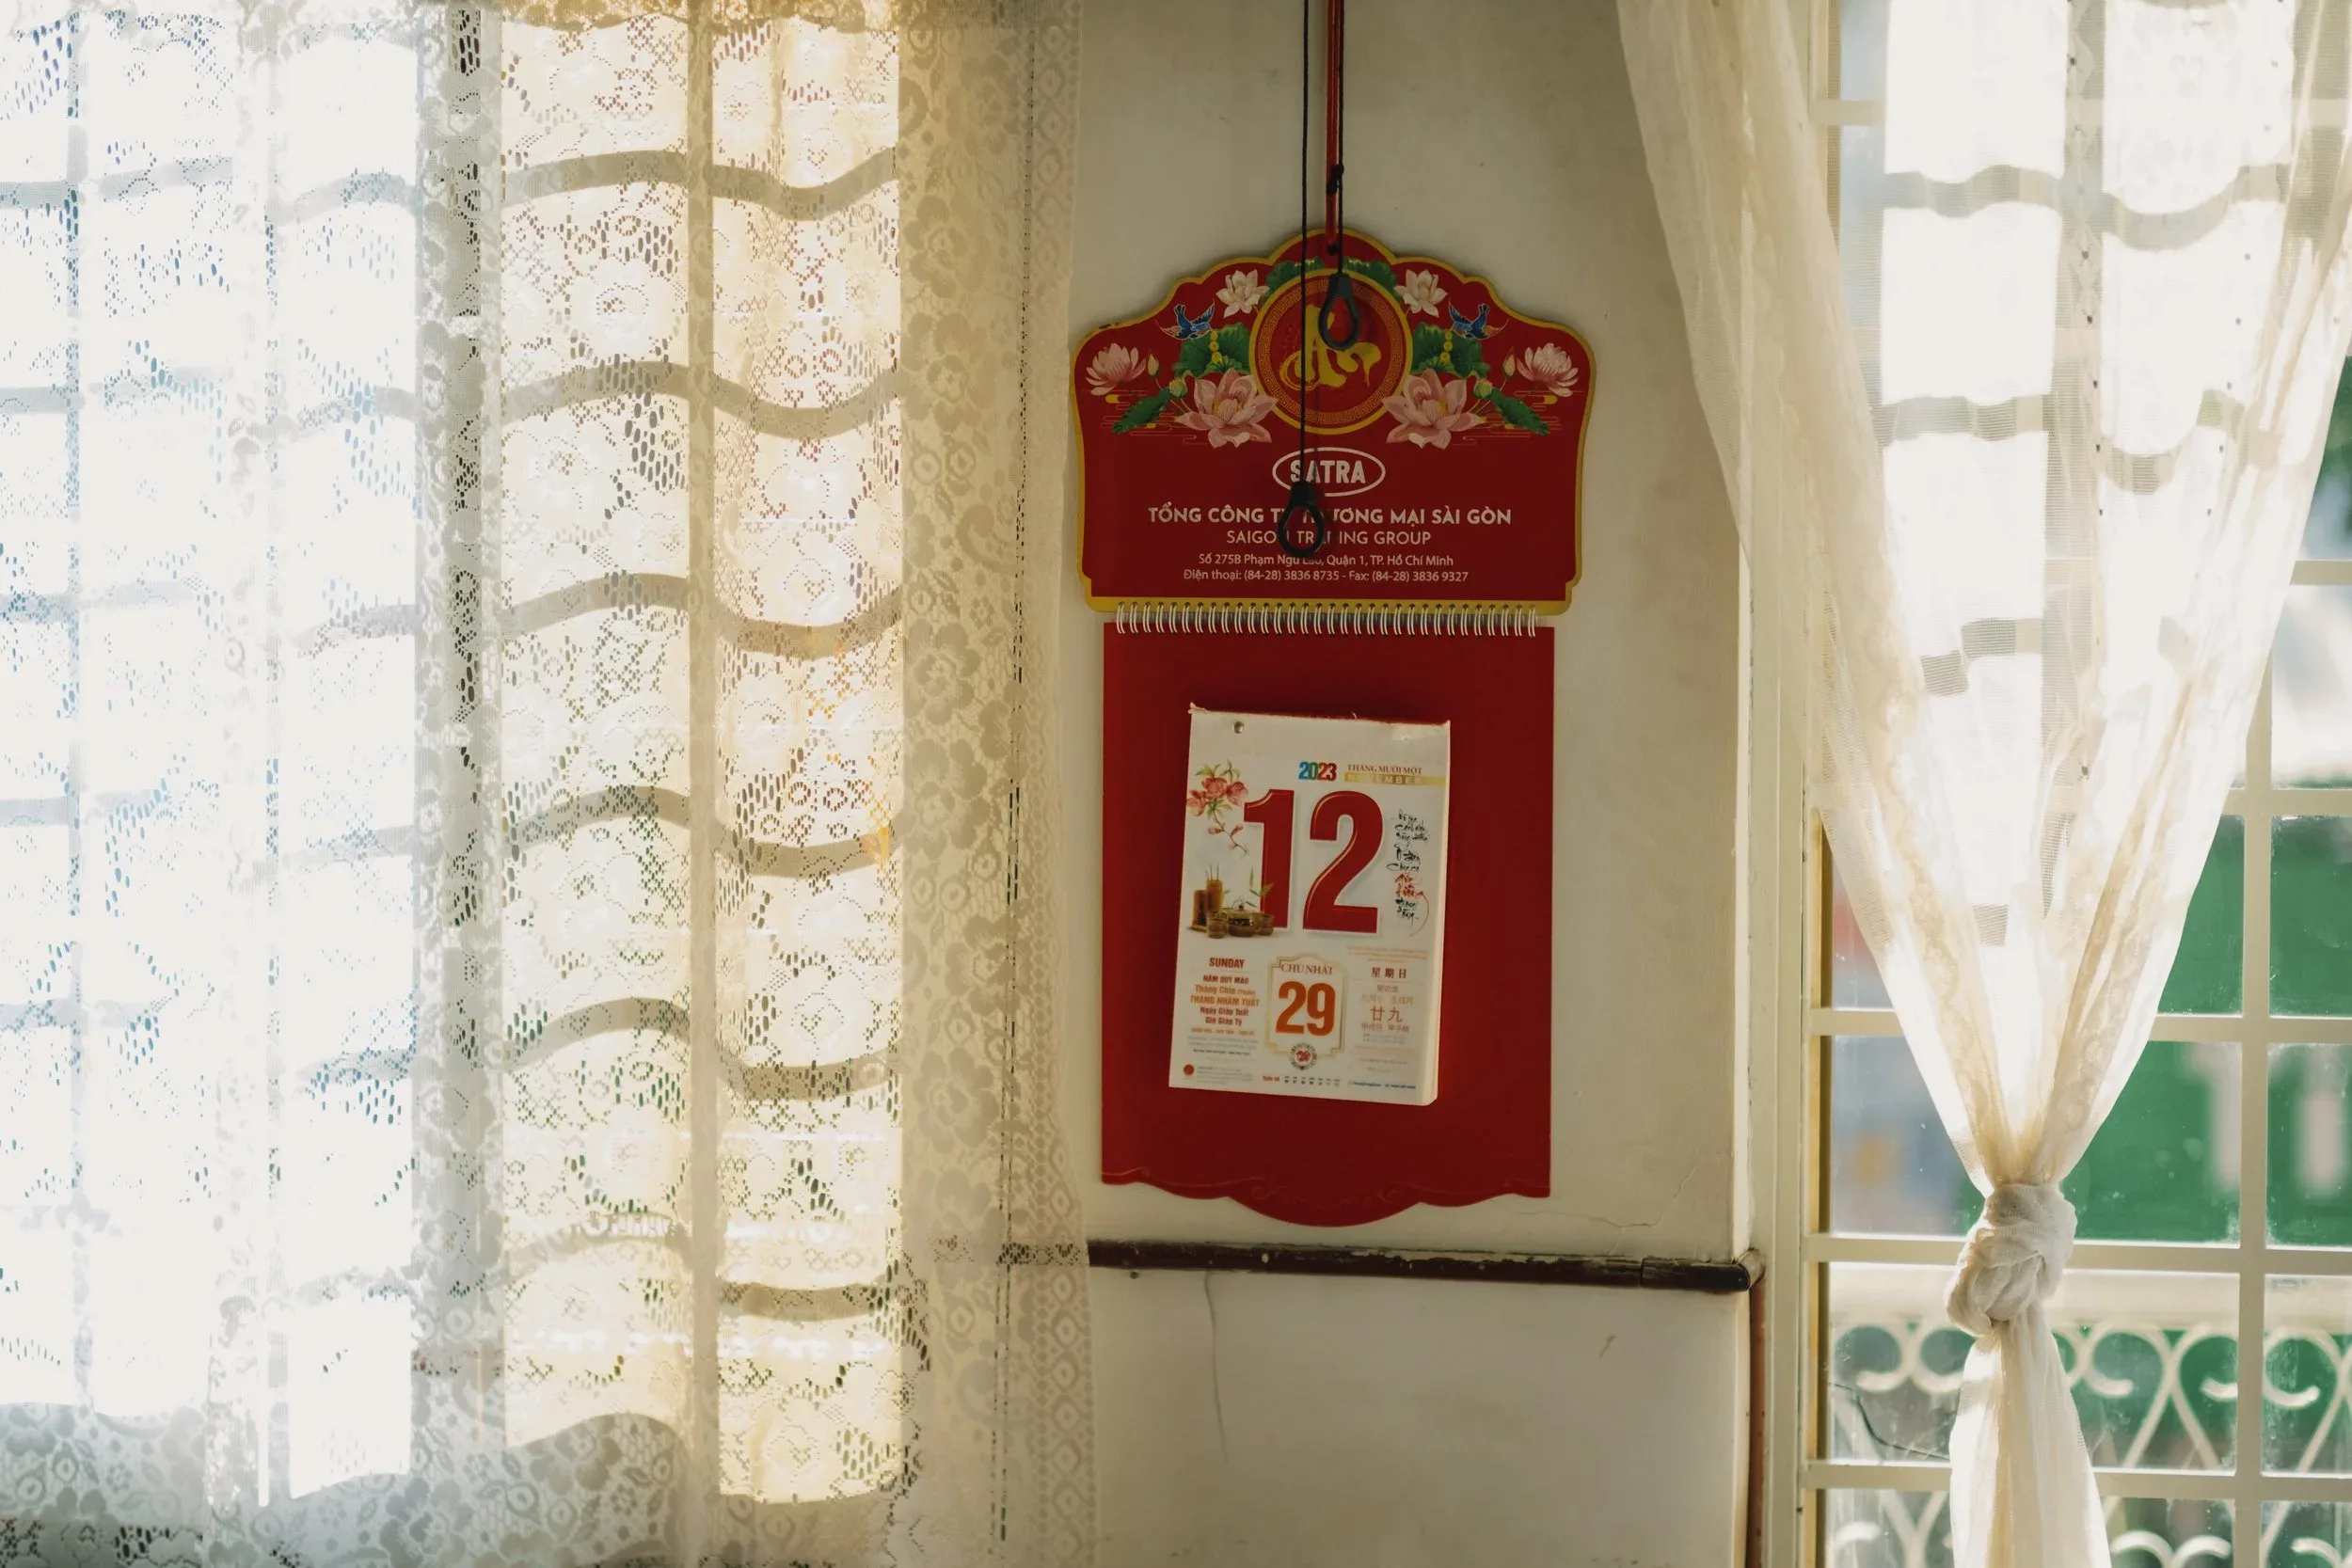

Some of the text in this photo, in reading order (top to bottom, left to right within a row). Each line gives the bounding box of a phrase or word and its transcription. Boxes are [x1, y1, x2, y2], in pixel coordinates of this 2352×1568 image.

[1290, 460, 1366, 483] SATRA
[1148, 501, 1201, 523] TỔNG
[1208, 504, 1263, 523] CÔNG
[1391, 509, 1425, 527] MẠI
[1431, 505, 1460, 525] SÀI
[1467, 506, 1511, 525] GÒN
[1296, 531, 1368, 545] TRING
[1374, 531, 1431, 545] GROUP
[1199, 552, 1212, 564] Số
[1215, 554, 1241, 564] 275B
[1244, 554, 1275, 566] Phạm
[1327, 554, 1356, 568] Quận
[1359, 555, 1368, 567] 1,
[1370, 555, 1384, 565] TP.
[1387, 553, 1403, 565] Hồ
[1405, 555, 1423, 565] Chí
[1425, 555, 1454, 566] Minh
[1184, 569, 1208, 581] Điện
[1212, 569, 1242, 581] thoại:
[1244, 570, 1280, 581] (84-28)
[1284, 570, 1311, 580] 3836
[1312, 571, 1339, 580] 8735
[1349, 570, 1370, 580] Fax:
[1372, 571, 1409, 582] (84-28)
[1412, 571, 1438, 581] 3836
[1442, 572, 1469, 582] 9327
[1298, 761, 1337, 782] 2023
[1244, 789, 1383, 933] 12
[1209, 957, 1245, 968] SUNDAY
[1371, 966, 1406, 979] 星期日
[1276, 981, 1336, 1037] 29
